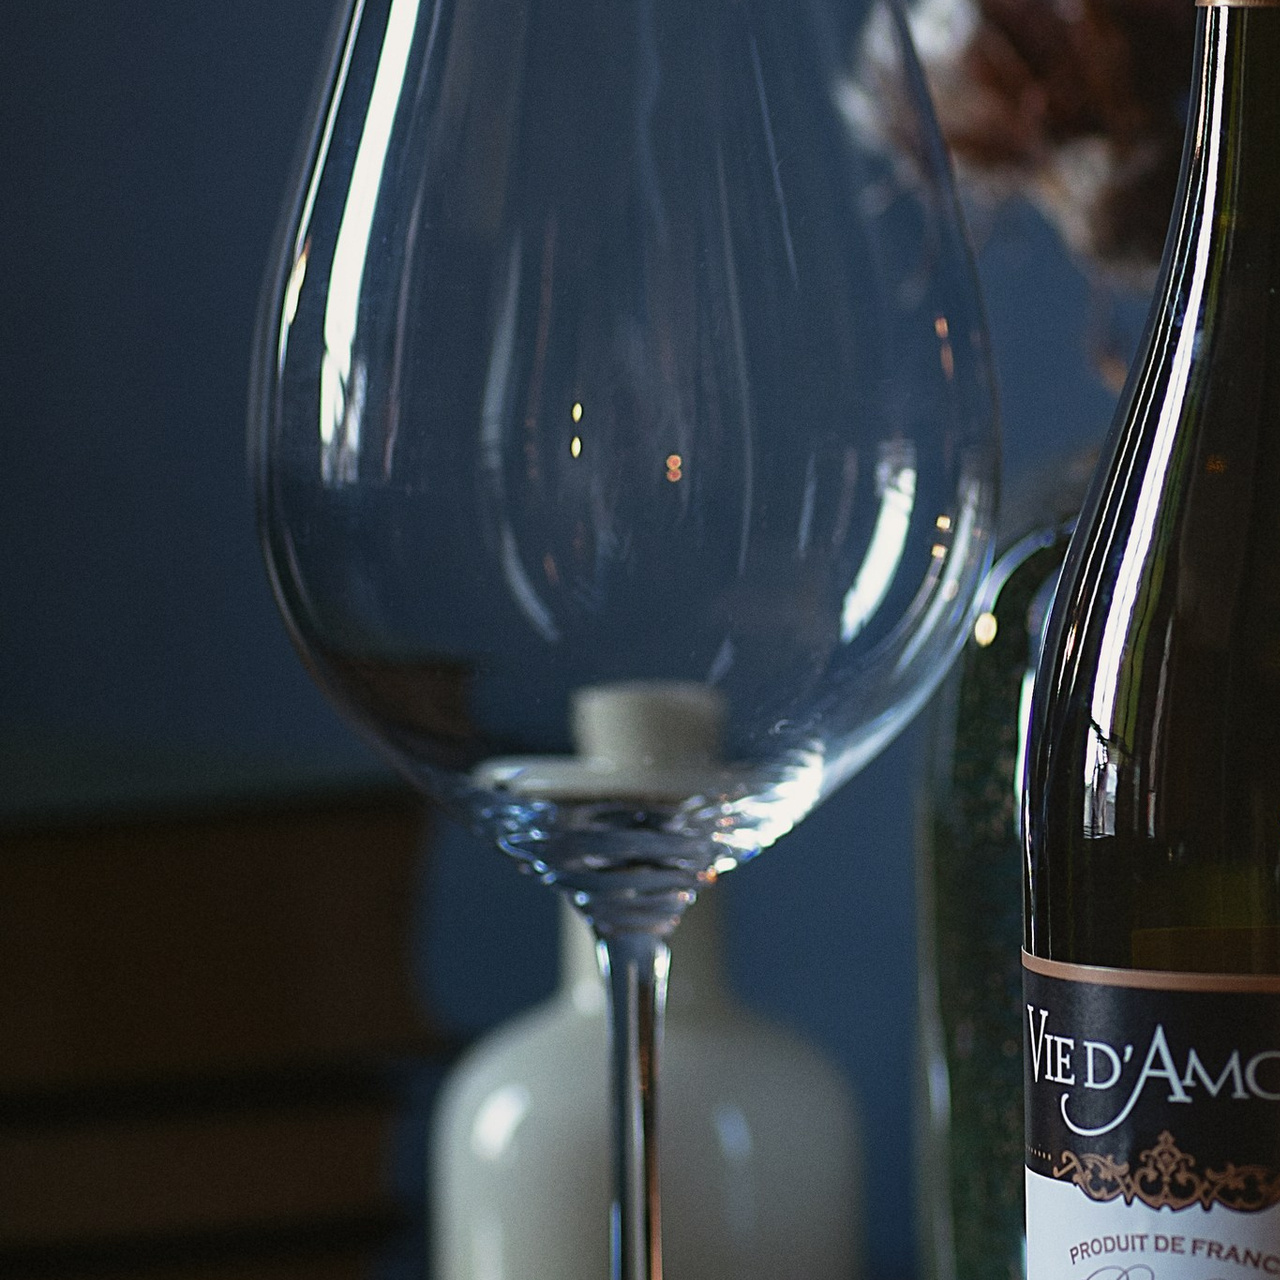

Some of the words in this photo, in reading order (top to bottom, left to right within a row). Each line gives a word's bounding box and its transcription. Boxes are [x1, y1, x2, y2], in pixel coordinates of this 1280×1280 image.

[1026, 1005, 1077, 1084] VIE
[1069, 1234, 1149, 1265] PRODUIT
[1155, 1235, 1185, 1255] DE
